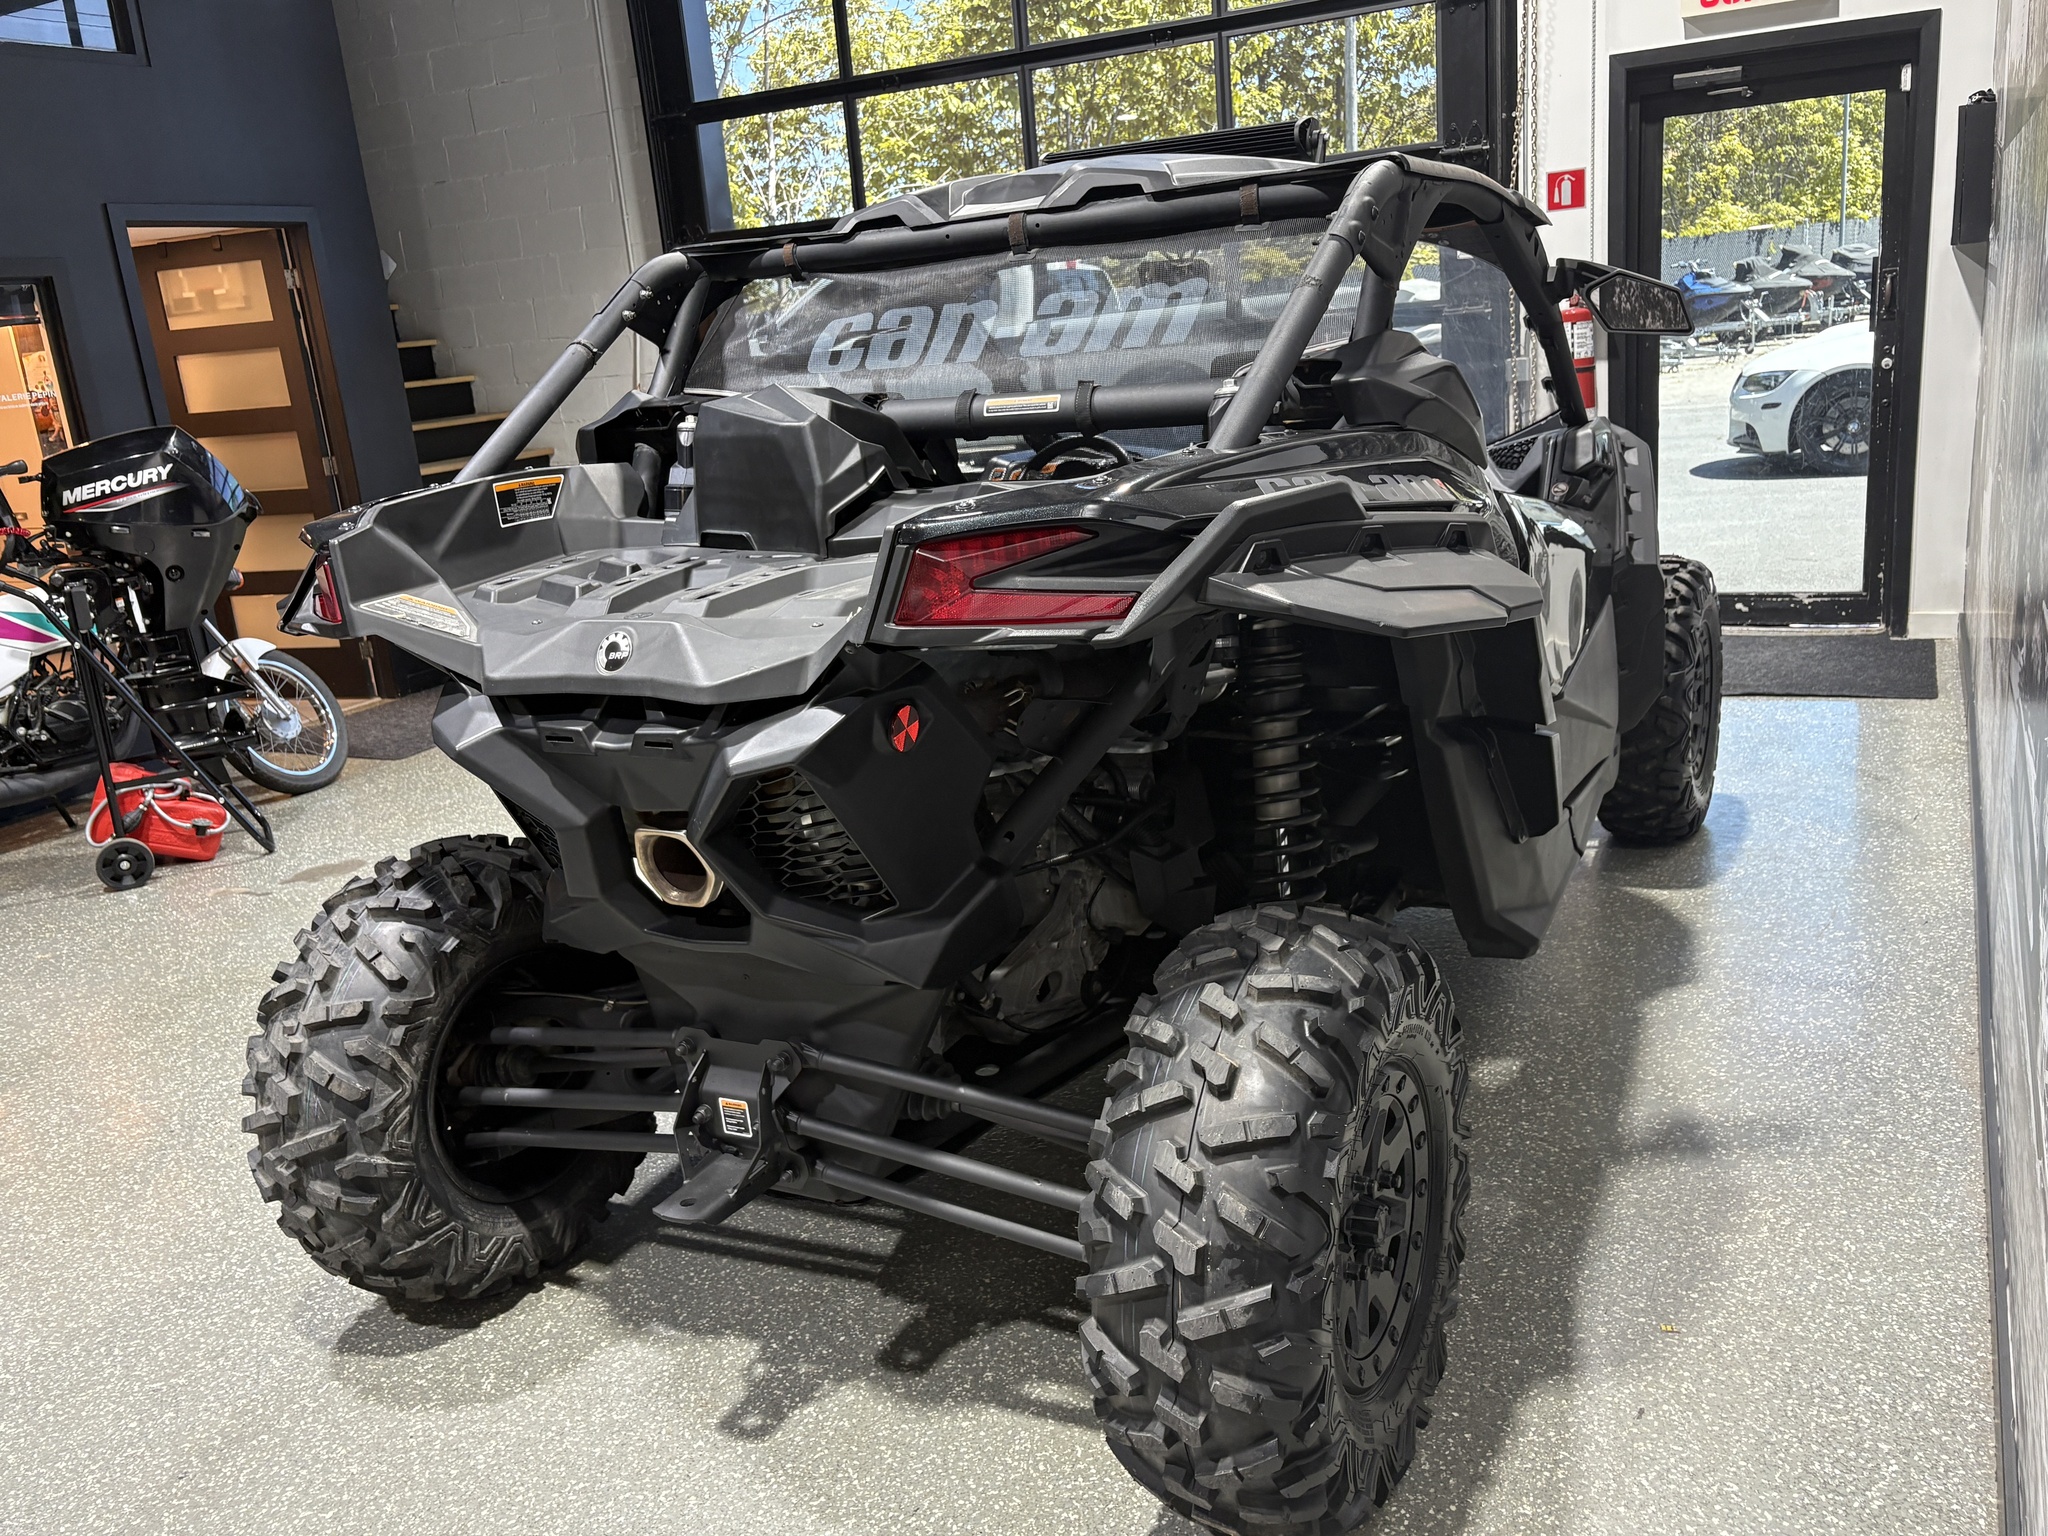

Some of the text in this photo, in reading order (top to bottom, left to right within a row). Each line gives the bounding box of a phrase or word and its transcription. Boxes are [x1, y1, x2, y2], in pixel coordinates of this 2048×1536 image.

[807, 278, 1209, 374] can-am
[0, 391, 31, 402] ALERIE
[62, 463, 174, 506] MERCURY
[608, 651, 629, 660] BRP
